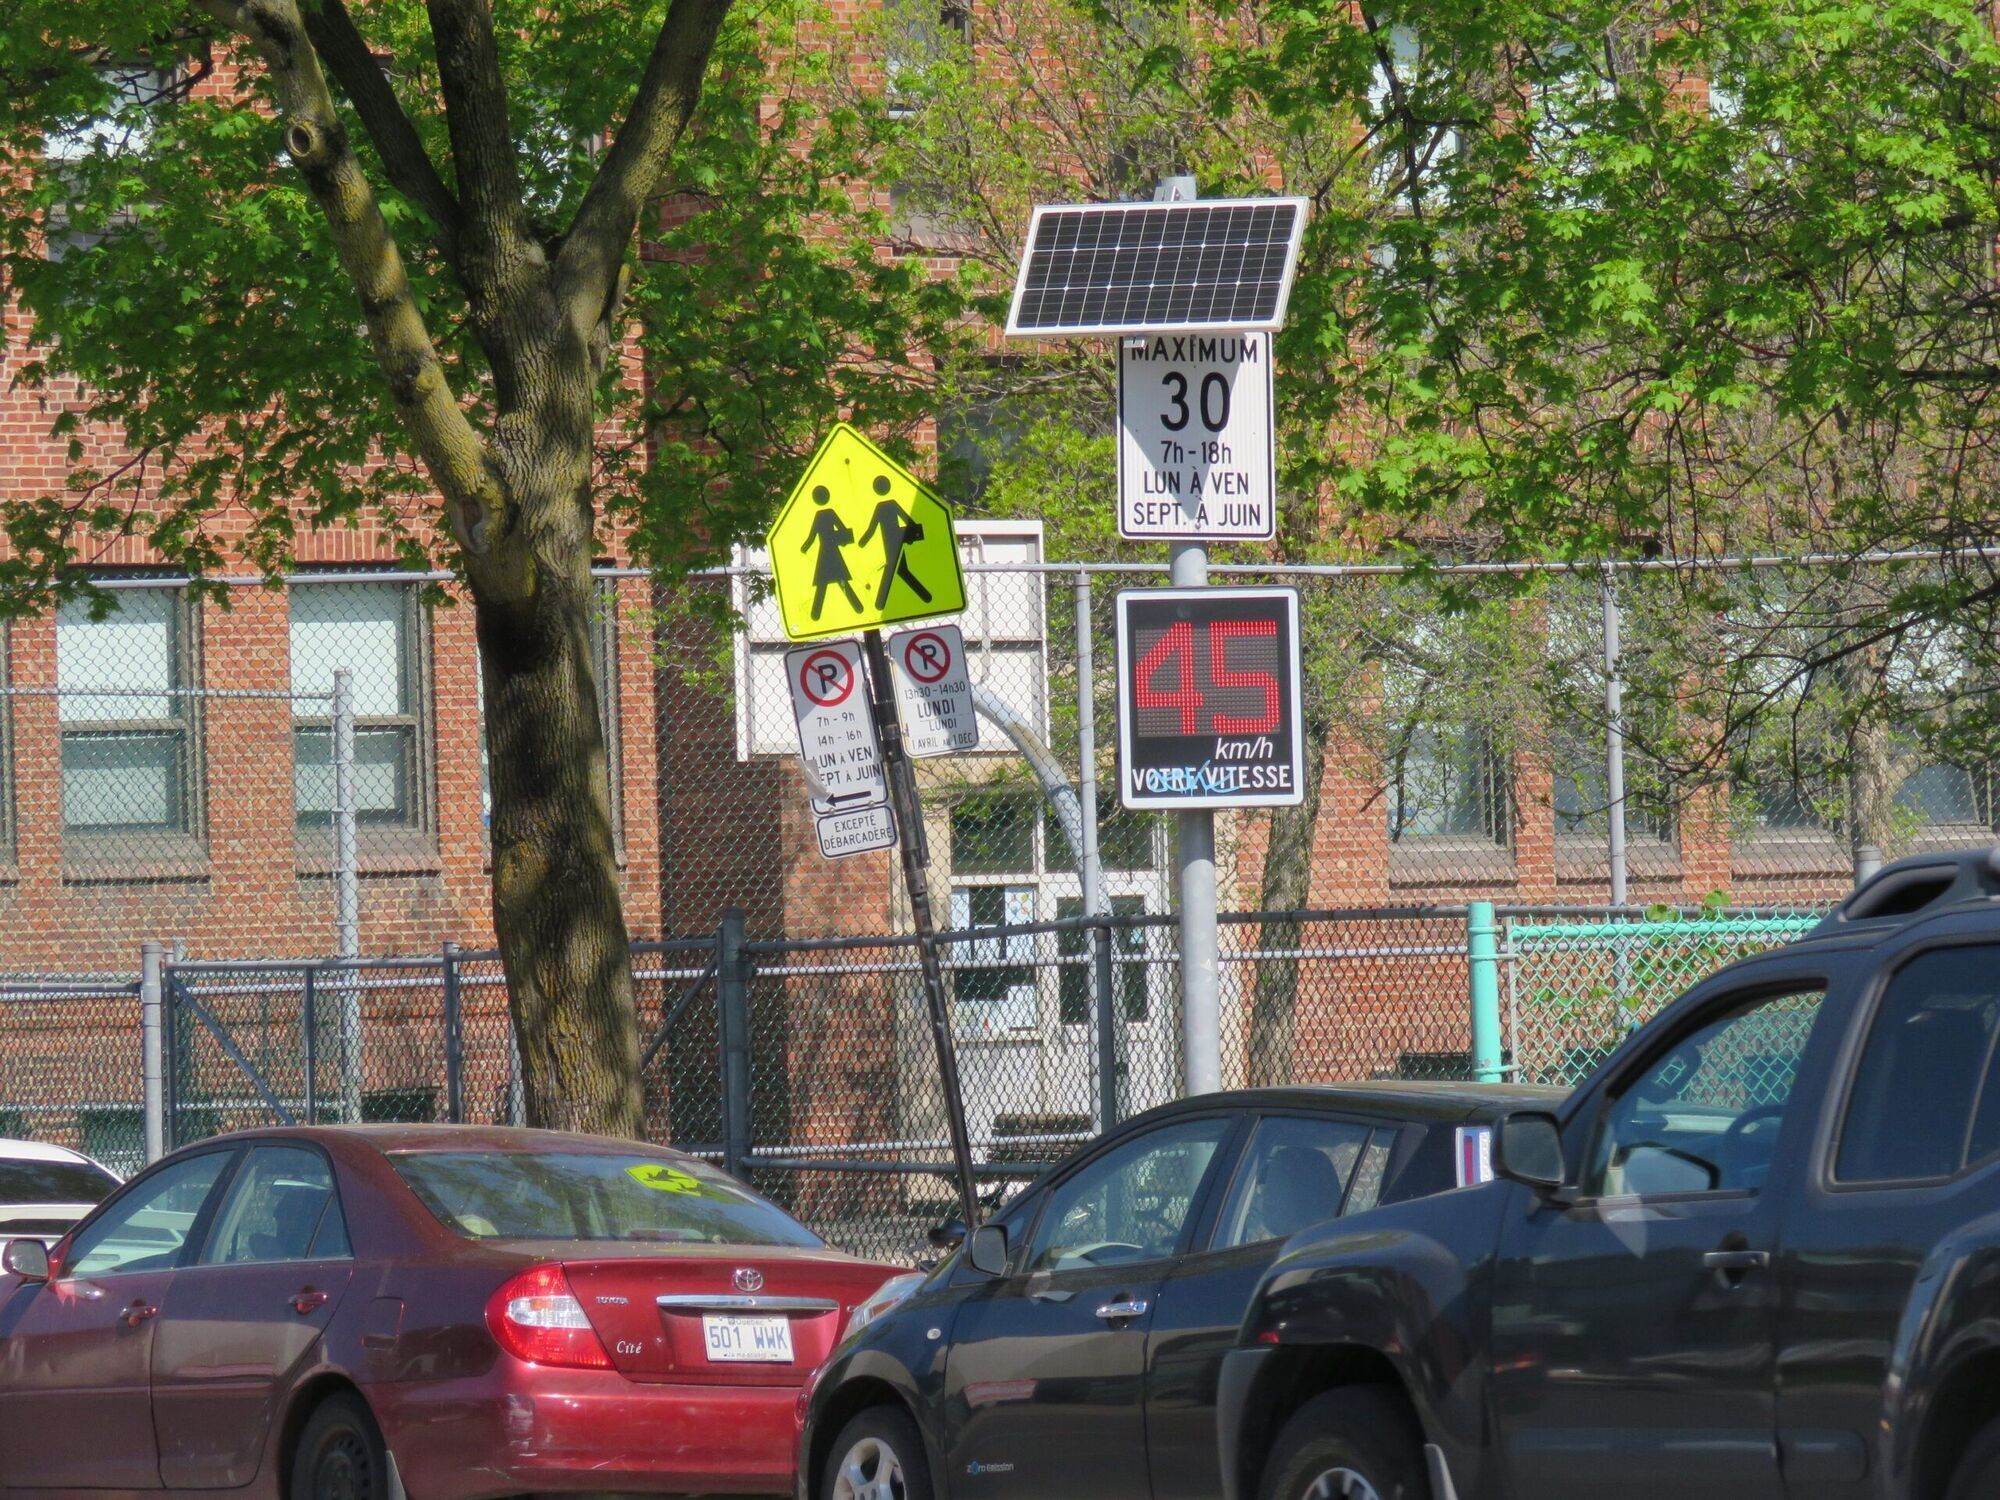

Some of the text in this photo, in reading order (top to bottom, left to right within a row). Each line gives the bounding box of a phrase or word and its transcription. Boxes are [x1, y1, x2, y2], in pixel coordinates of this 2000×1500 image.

[1131, 336, 1258, 363] MAXIMUM
[1160, 371, 1231, 433] 30
[1144, 467, 1249, 496] LUN À VEN
[1133, 496, 1261, 527] SEPT. À JUIN
[1135, 620, 1281, 736] 45
[917, 699, 955, 718] LUNDI
[929, 718, 957, 732] LUNDI
[848, 745, 873, 763] VEN
[918, 738, 939, 750] AVRIL
[1215, 736, 1274, 760] km/h
[856, 762, 882, 781] JUIN
[1205, 764, 1292, 789] VITESSE
[834, 812, 877, 833] EXCEPTÉ
[616, 1340, 643, 1354] Cité
[709, 1326, 788, 1350] 501 WWK
